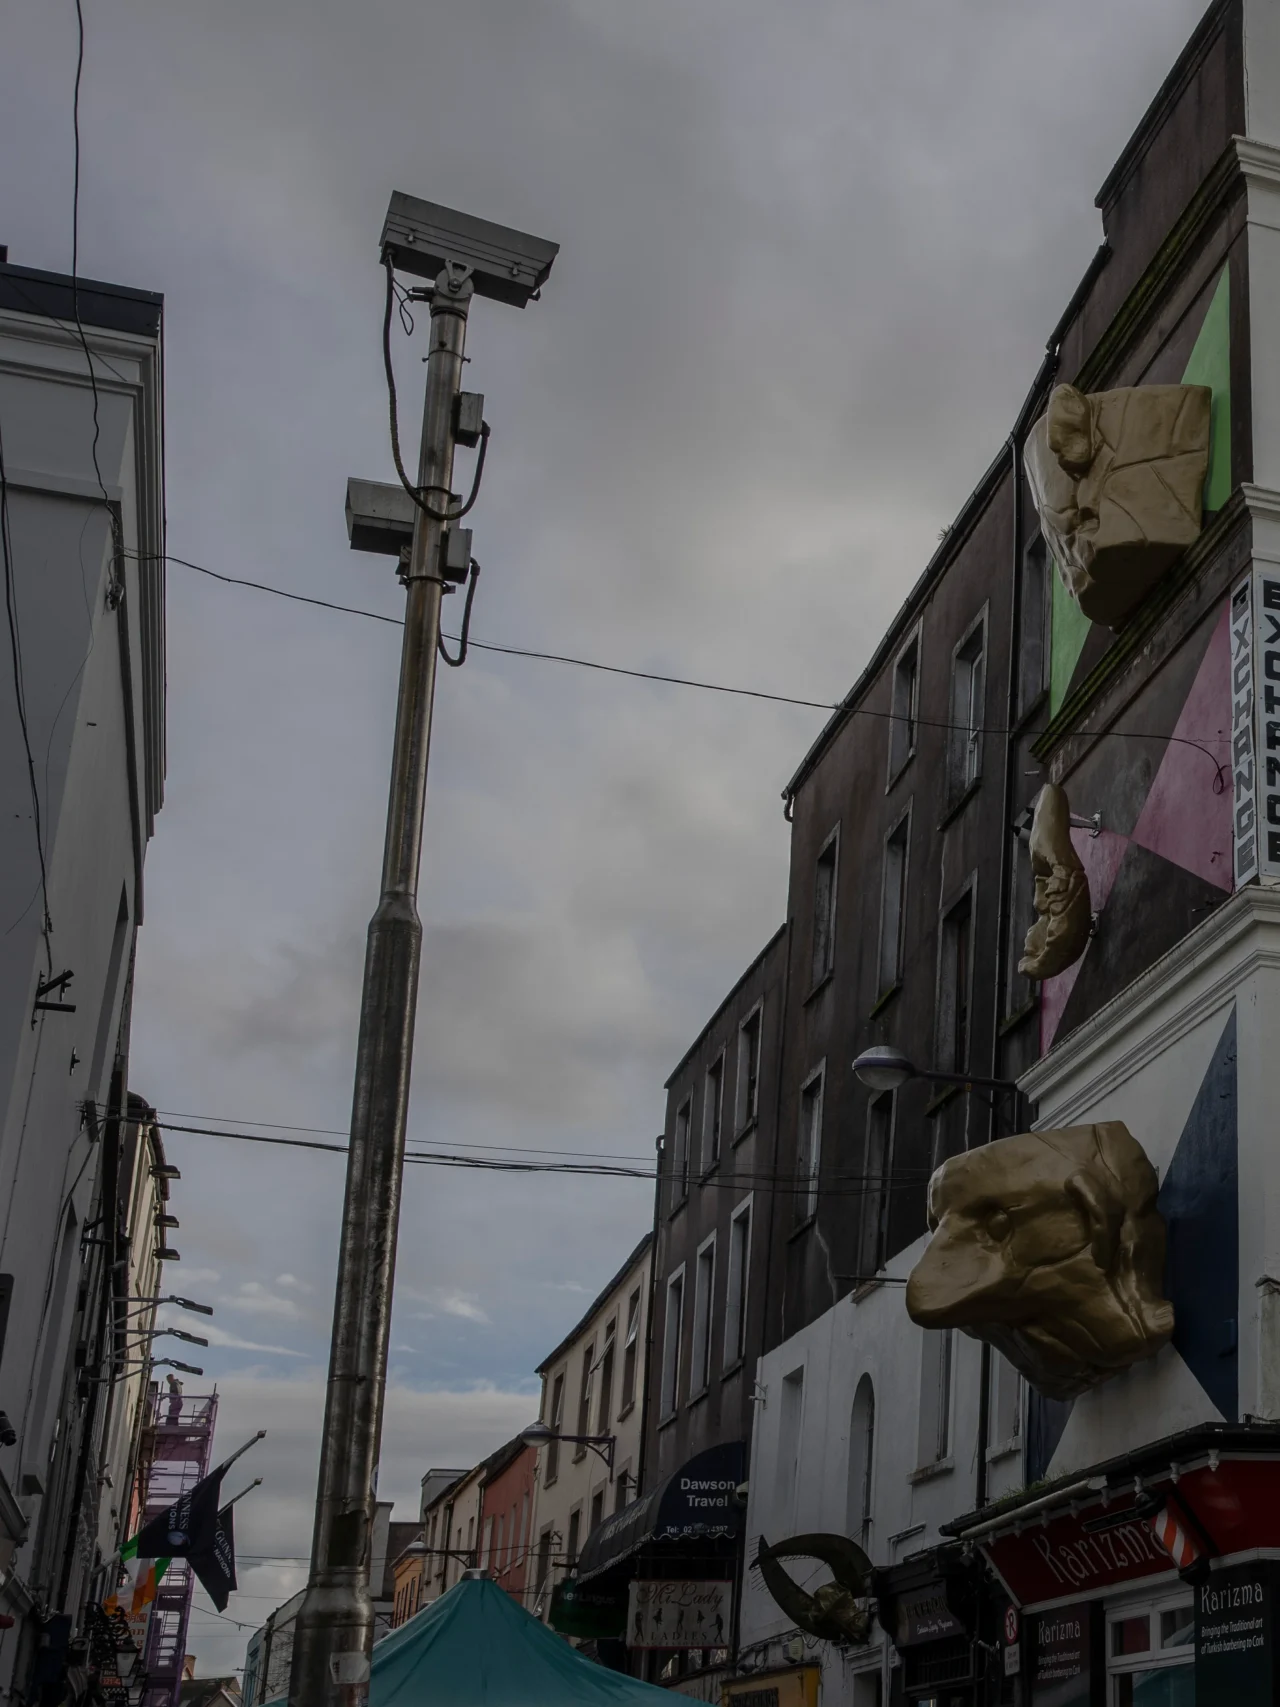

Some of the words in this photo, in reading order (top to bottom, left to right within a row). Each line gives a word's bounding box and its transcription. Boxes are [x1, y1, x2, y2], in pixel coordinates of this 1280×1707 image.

[1232, 581, 1255, 878] EXCHANGE
[680, 1478, 736, 1490] Dawson
[686, 1494, 728, 1507] Travel
[666, 1525, 679, 1533] Tel:
[1201, 1582, 1263, 1615] Karizma
[651, 1632, 707, 1640] LADIES
[1038, 1620, 1080, 1647] Karizma
[1201, 1625, 1220, 1639] Bringing
[1221, 1622, 1229, 1634] the
[1229, 1617, 1254, 1633] Traditional
[1255, 1618, 1263, 1628] art
[1201, 1643, 1206, 1654] of
[1206, 1640, 1222, 1654] Turkish
[1223, 1638, 1246, 1651] barbering
[1247, 1638, 1252, 1648] to
[1252, 1633, 1264, 1647] Cork
